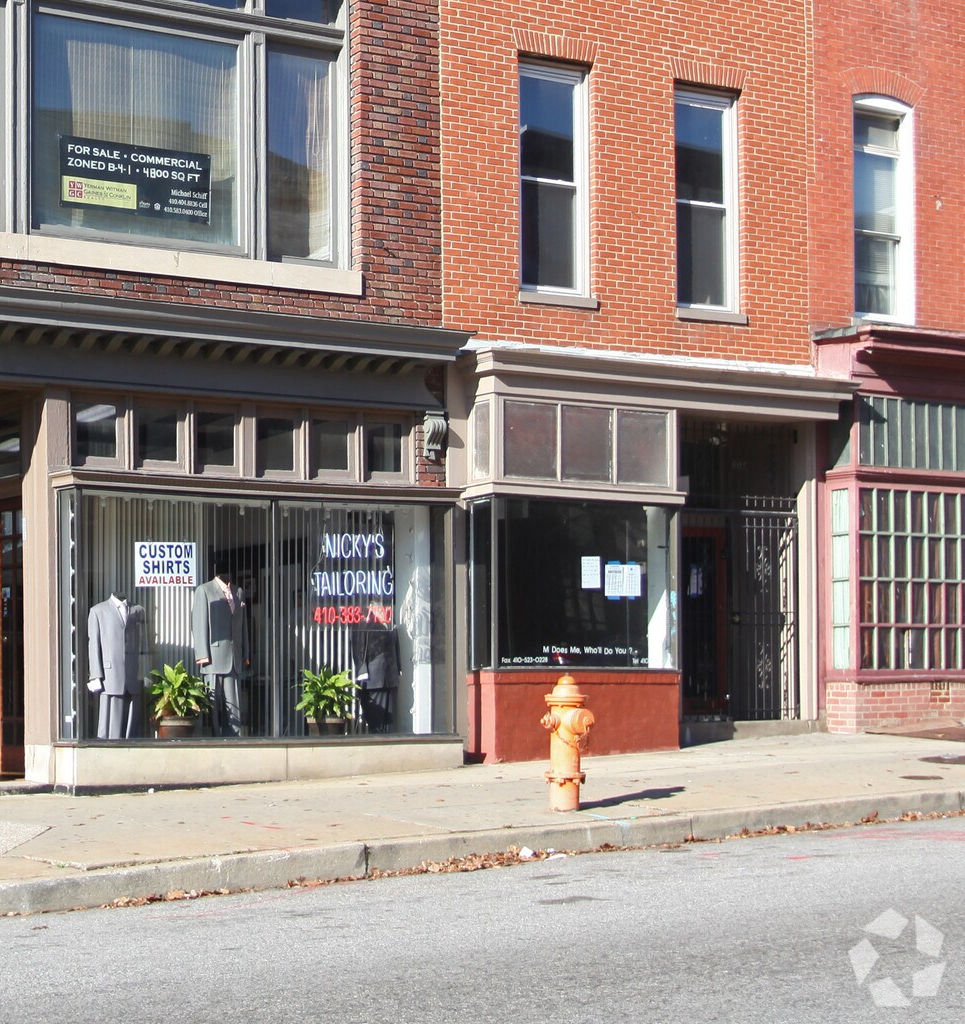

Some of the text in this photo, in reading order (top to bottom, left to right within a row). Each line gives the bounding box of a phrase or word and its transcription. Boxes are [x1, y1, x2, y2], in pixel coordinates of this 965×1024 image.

[67, 143, 203, 171] FOR SALE COMMERCIAL
[67, 157, 106, 171] ZONED
[143, 167, 170, 179] 4800
[171, 171, 185, 182] SQ
[187, 173, 201, 183] FT
[171, 189, 208, 200] Michael Schiff
[194, 210, 208, 218] Office
[139, 544, 193, 558] CUSTOM
[325, 533, 385, 558] NICKY'S
[143, 560, 190, 574] SHIRTS
[139, 576, 193, 584] AVAILABLE
[313, 570, 393, 597] TAILORING
[551, 646, 568, 654] Does
[569, 646, 582, 655] Me,
[584, 646, 603, 654] Who'll
[604, 647, 613, 655] Do
[615, 647, 627, 655] You
